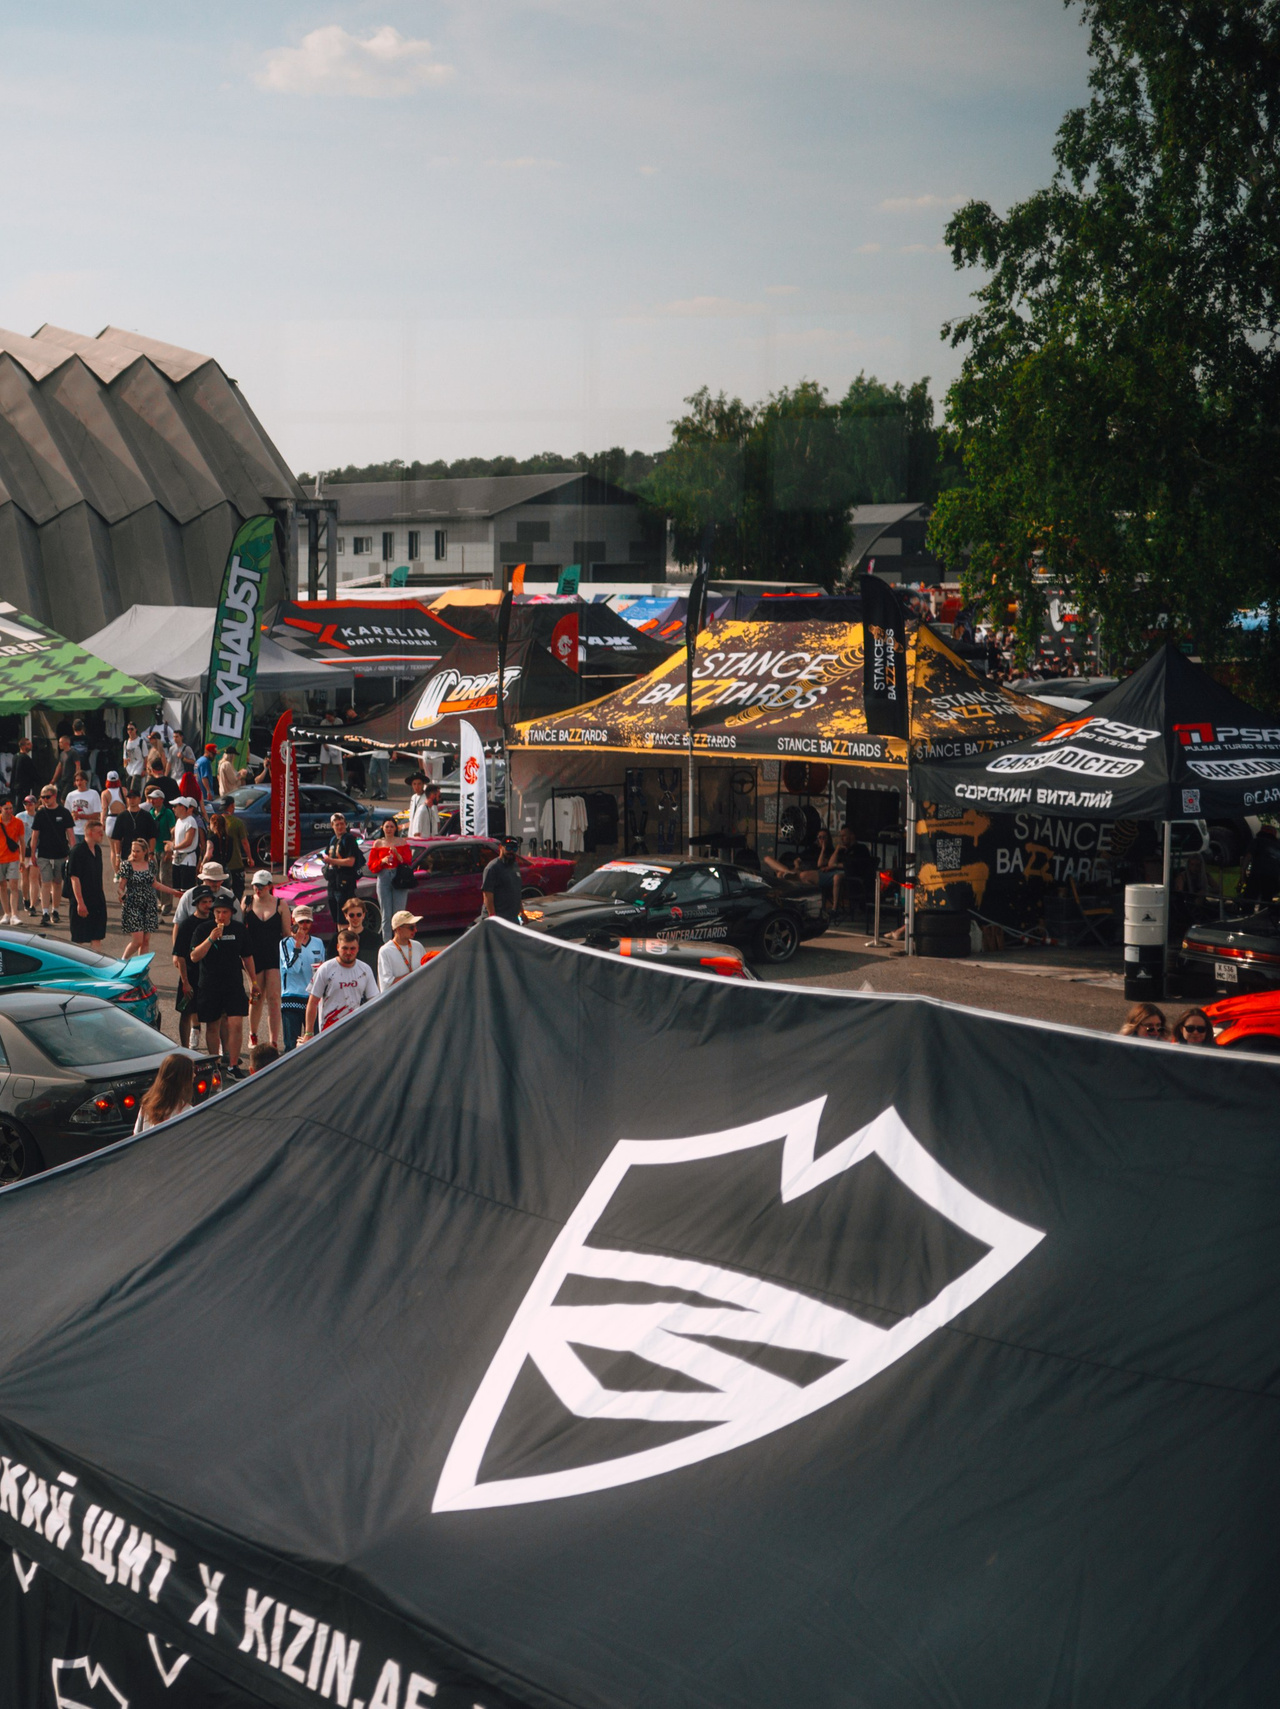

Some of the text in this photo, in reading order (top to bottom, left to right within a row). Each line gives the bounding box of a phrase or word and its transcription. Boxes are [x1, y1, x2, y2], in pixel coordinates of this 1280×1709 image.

[341, 624, 431, 639] KARELIN
[347, 637, 438, 647] DRIFT ACADEMY
[210, 555, 261, 739] EXHAUST
[692, 651, 840, 679] STANCE
[874, 638, 886, 691] STANCE
[887, 628, 897, 700] BAZZTARDS
[447, 667, 522, 702] DRIFT
[637, 679, 828, 709] BAZZTARDS
[467, 696, 495, 708] EXPO
[931, 690, 1012, 709] STANCE
[523, 729, 608, 742] STANCE BAZZTARDS
[644, 732, 680, 746] STANCE
[1080, 717, 1162, 744] PSR
[1216, 727, 1280, 743] PSR
[777, 737, 881, 758] STANCE BAZZTARDS
[916, 743, 961, 759] STANCE
[1184, 744, 1222, 752] PULSAR
[1191, 760, 1280, 778] CARSADD
[955, 783, 1114, 809] СОРОКИН ВИТАЛИЙ
[1014, 812, 1115, 851] STANCE
[82, 1503, 177, 1604] ЩИТ
